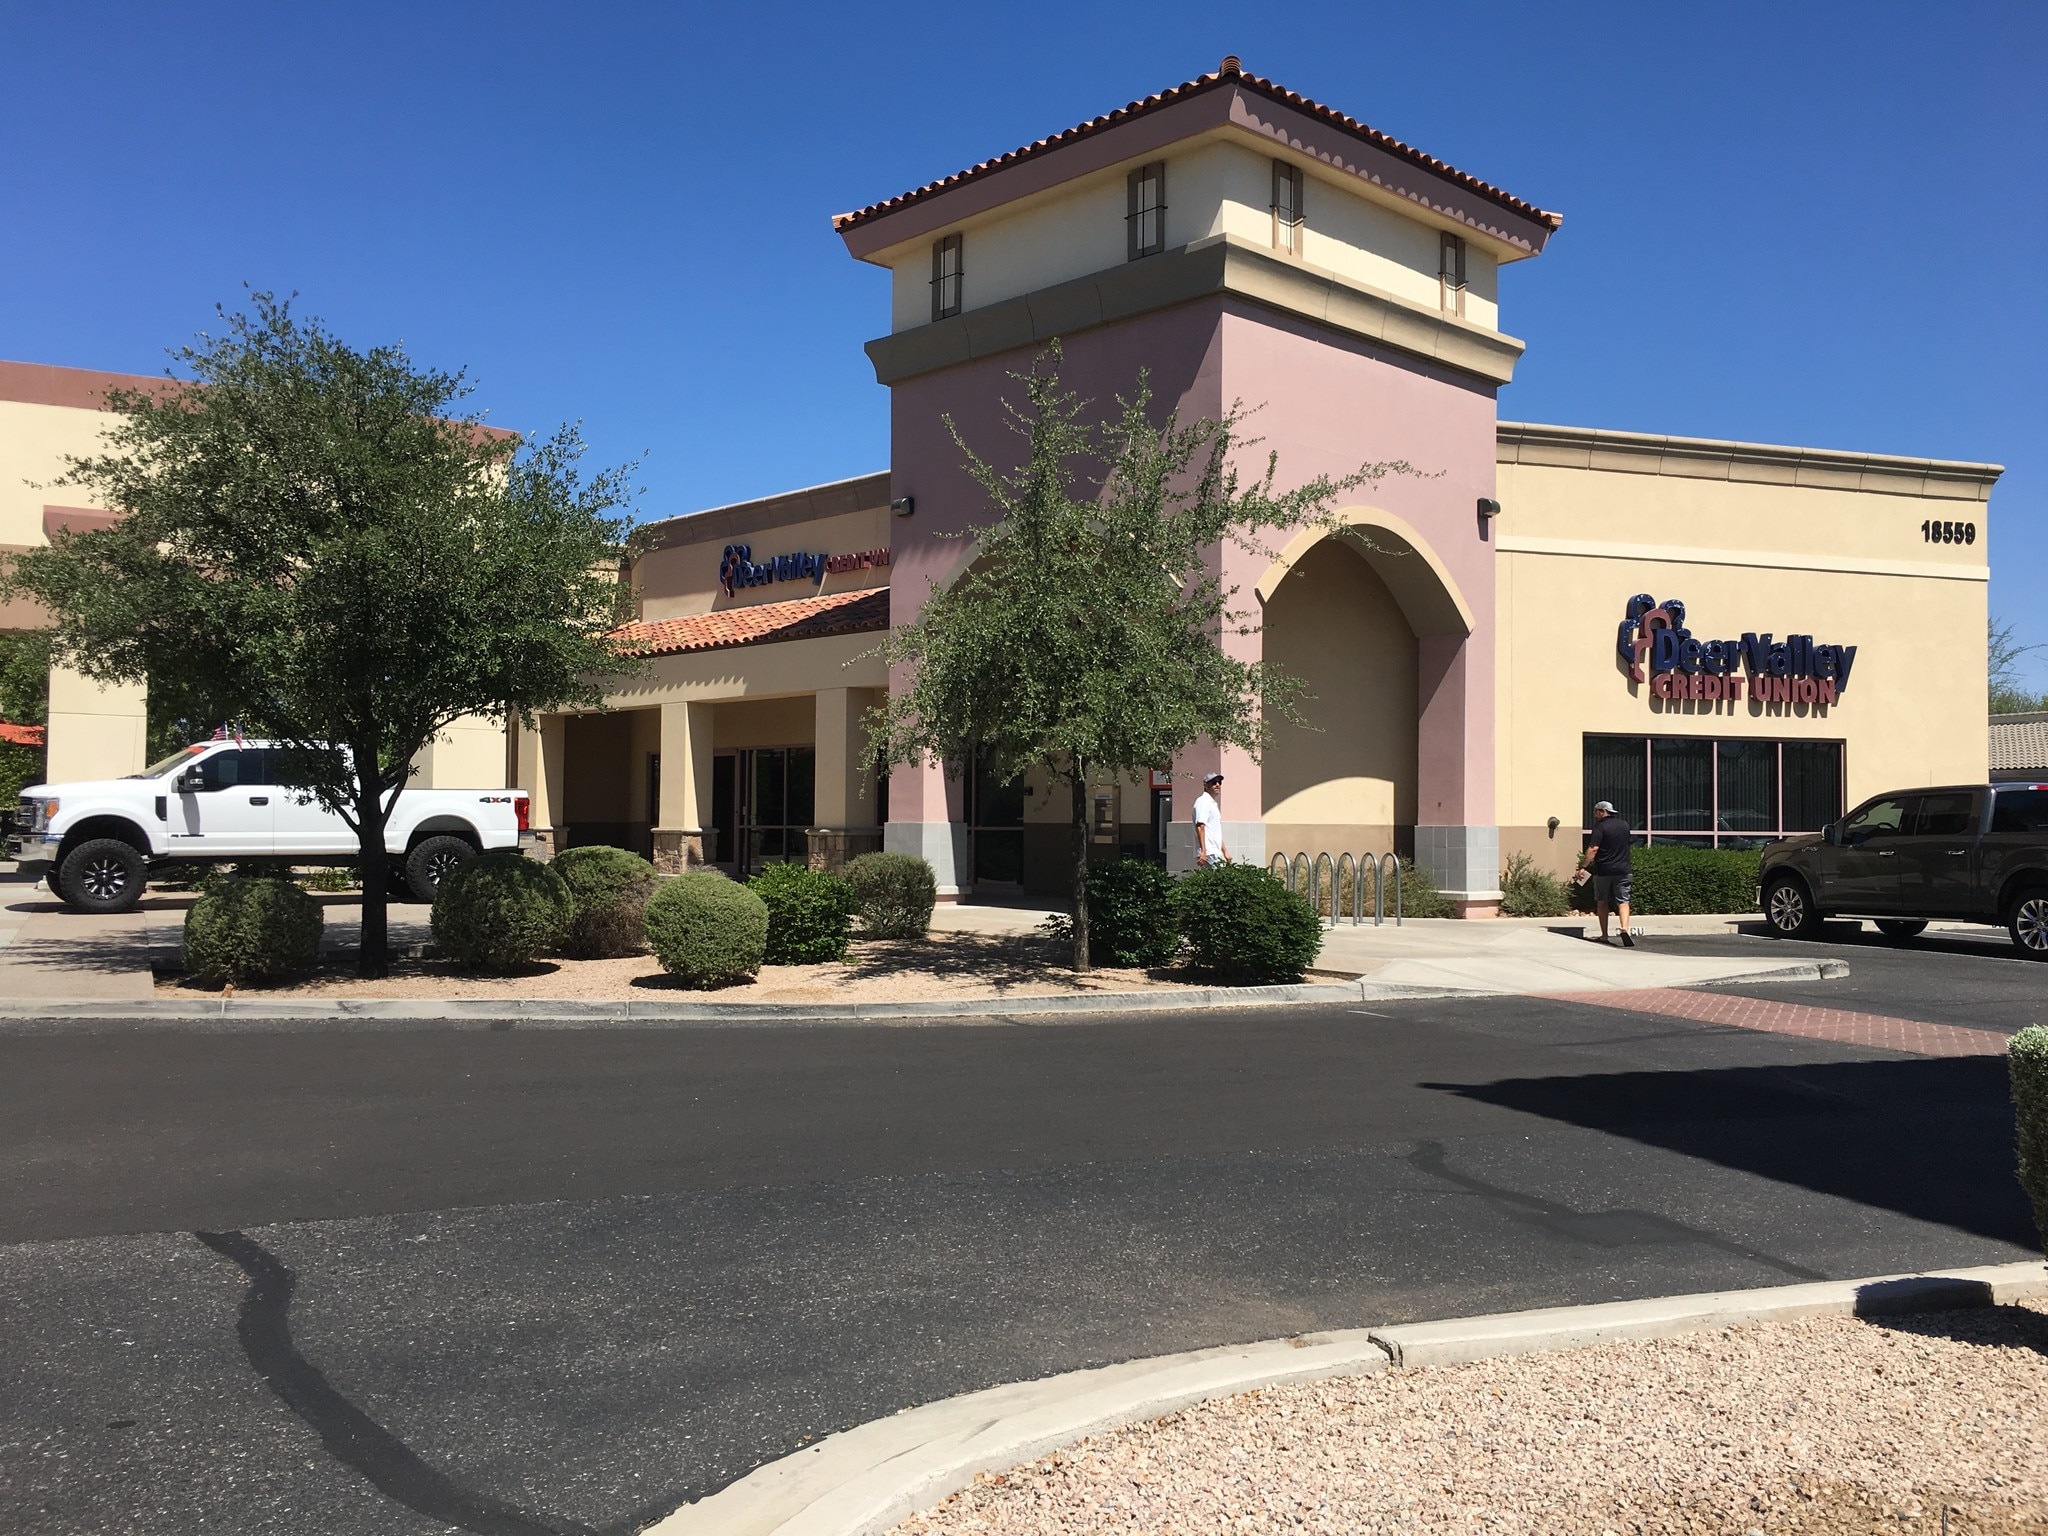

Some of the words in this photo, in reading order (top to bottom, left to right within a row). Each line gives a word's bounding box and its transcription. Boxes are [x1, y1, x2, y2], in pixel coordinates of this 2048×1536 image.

[1921, 520, 1976, 546] 18559
[824, 552, 868, 574] CREDIT
[1651, 674, 1746, 701] CREDIT
[1748, 676, 1836, 704] UNION
